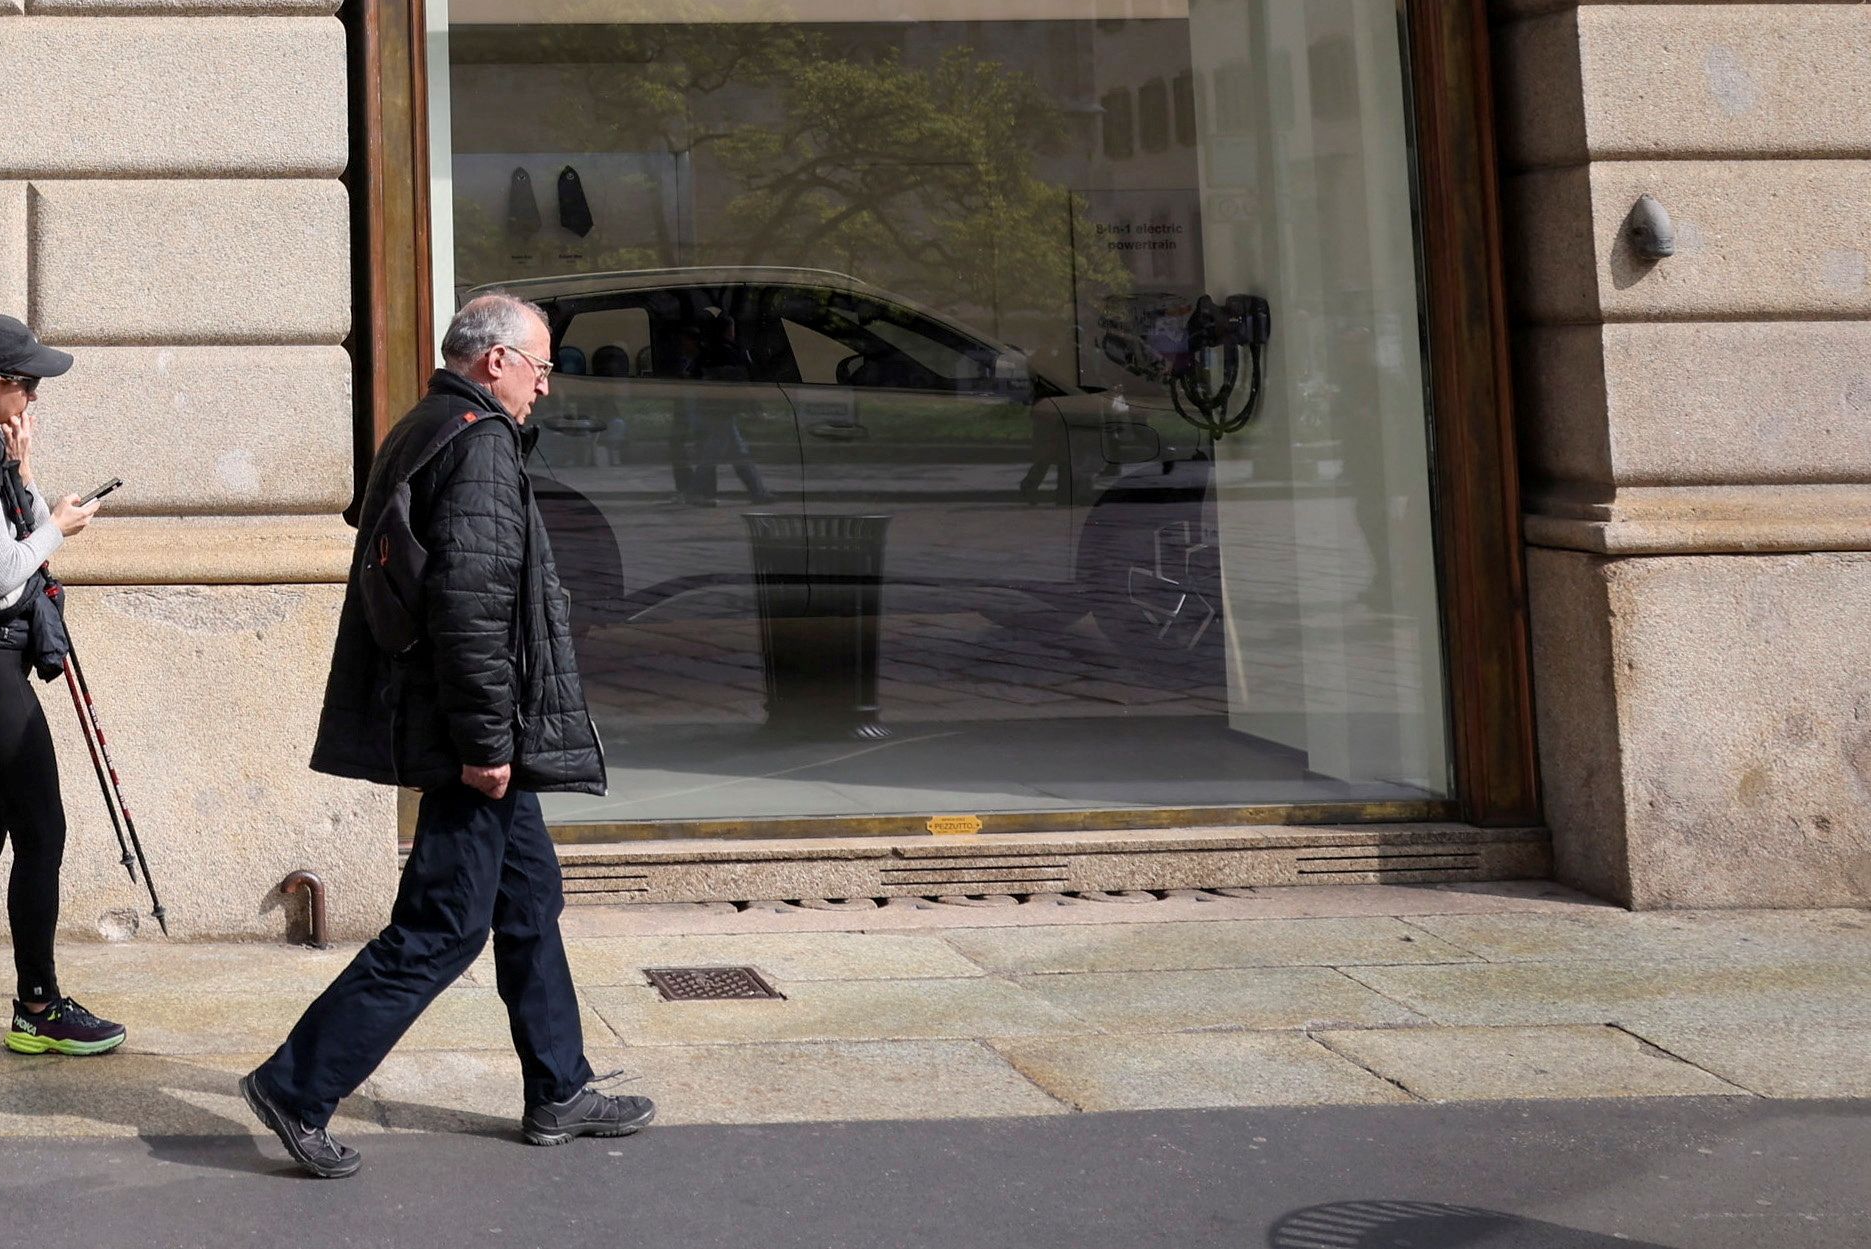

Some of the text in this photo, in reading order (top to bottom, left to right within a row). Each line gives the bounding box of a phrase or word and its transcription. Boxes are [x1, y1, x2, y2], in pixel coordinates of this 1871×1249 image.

[1135, 223, 1183, 234] electric
[1108, 239, 1177, 252] powertrain
[14, 1015, 37, 1036] HOKA
